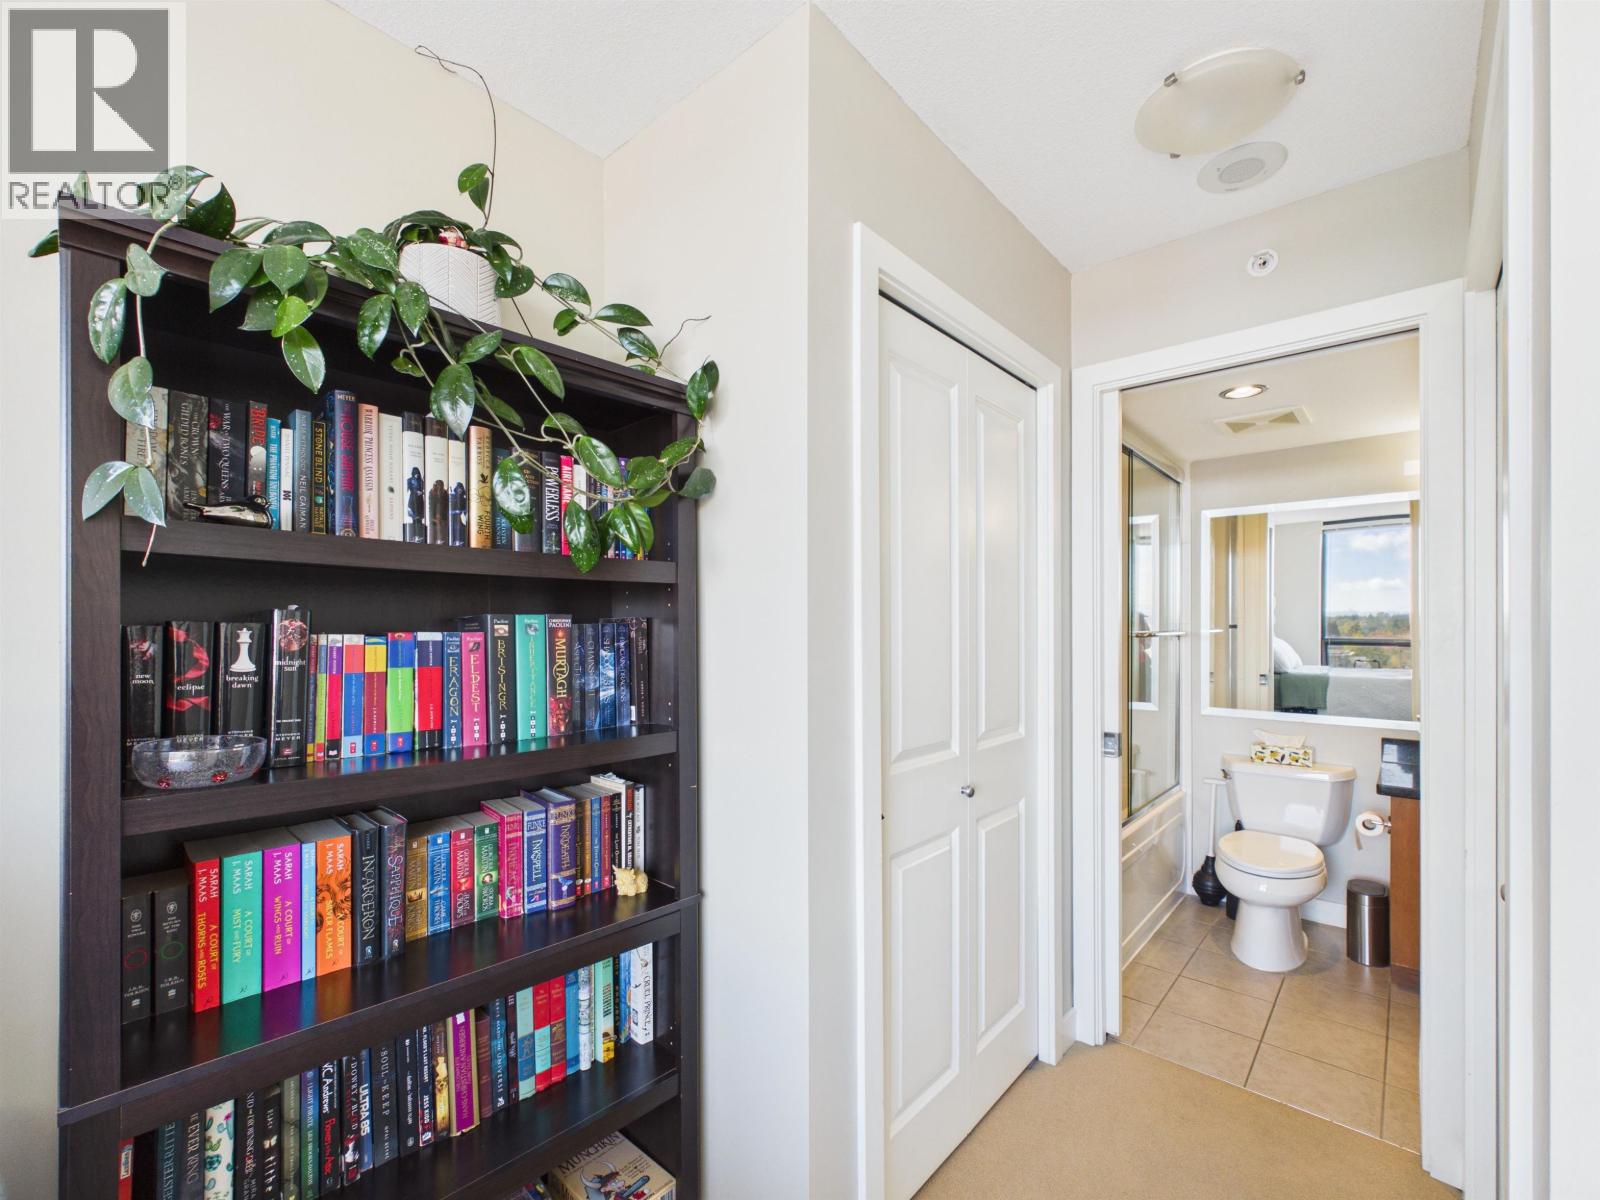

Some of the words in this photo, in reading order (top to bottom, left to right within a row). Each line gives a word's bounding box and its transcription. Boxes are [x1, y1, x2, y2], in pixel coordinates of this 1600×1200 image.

[336, 393, 356, 402] MEYER
[180, 403, 191, 436] GILDED
[222, 413, 231, 430] WAR
[250, 407, 266, 446] BRIDE
[180, 437, 190, 466] BONES
[190, 420, 201, 454] CROWN
[220, 436, 231, 457] TWO
[314, 427, 324, 455] STONE
[364, 435, 374, 465] PRINCESS
[218, 456, 231, 490] QUEENS
[269, 453, 278, 480] PHANTOM
[314, 457, 324, 484] BLIND
[299, 474, 307, 493] NEIL
[561, 465, 574, 503] AIRFAME
[299, 495, 307, 529] GAIMAN
[477, 514, 485, 536] WING
[484, 510, 492, 541] FOURTH
[275, 656, 306, 667] midnight
[497, 640, 507, 711] BRISINGR
[553, 638, 570, 699] MURTAGH
[177, 683, 205, 695] eclipse
[226, 674, 259, 682] breaking
[448, 656, 460, 717] ERAGON
[470, 654, 481, 713] ELDEST
[527, 820, 546, 831] FUNKE
[481, 845, 489, 873] MARTIN
[531, 838, 543, 882] INKSPELL
[560, 824, 571, 868] INKDEATH
[244, 860, 253, 890] SARAH
[273, 860, 282, 885] MAAS
[284, 852, 293, 880] SARAH
[326, 852, 334, 875] MAAS
[456, 850, 464, 879] MARTIN
[198, 876, 207, 903] MAAS
[209, 868, 219, 898] SARAH
[232, 868, 241, 895] MAAS
[387, 855, 403, 927] SAPPHIQUE
[273, 896, 282, 923] WINGS
[361, 854, 376, 941] INCARCERON
[456, 893, 464, 918] CROWS
[232, 908, 241, 929] MIST
[325, 899, 334, 926] SILVER
[197, 911, 207, 949] THORNS
[244, 919, 253, 949] COURT
[274, 934, 282, 955] RUIN
[325, 927, 334, 960] FLAMES
[209, 933, 218, 962] COURT
[232, 941, 241, 963] FURY
[197, 960, 206, 989] ROSES
[643, 975, 651, 998] CRUEL
[643, 1001, 651, 1027] PRINCE
[381, 1050, 390, 1077] SOUL
[497, 1052, 505, 1093] UNIVERSE
[246, 1091, 254, 1108] NTO
[322, 1078, 333, 1114] Andrews
[360, 1083, 370, 1121] ULTRA
[382, 1085, 391, 1116] KEEP
[187, 1122, 200, 1154] EVER
[245, 1114, 255, 1155] DROWNING
[360, 1121, 370, 1136] 85
[163, 1121, 176, 1200] EISTERRITTE
[558, 1132, 621, 1175] MUNCHKIN
[186, 1154, 199, 1185] KING
[265, 1155, 277, 1192] tithe
